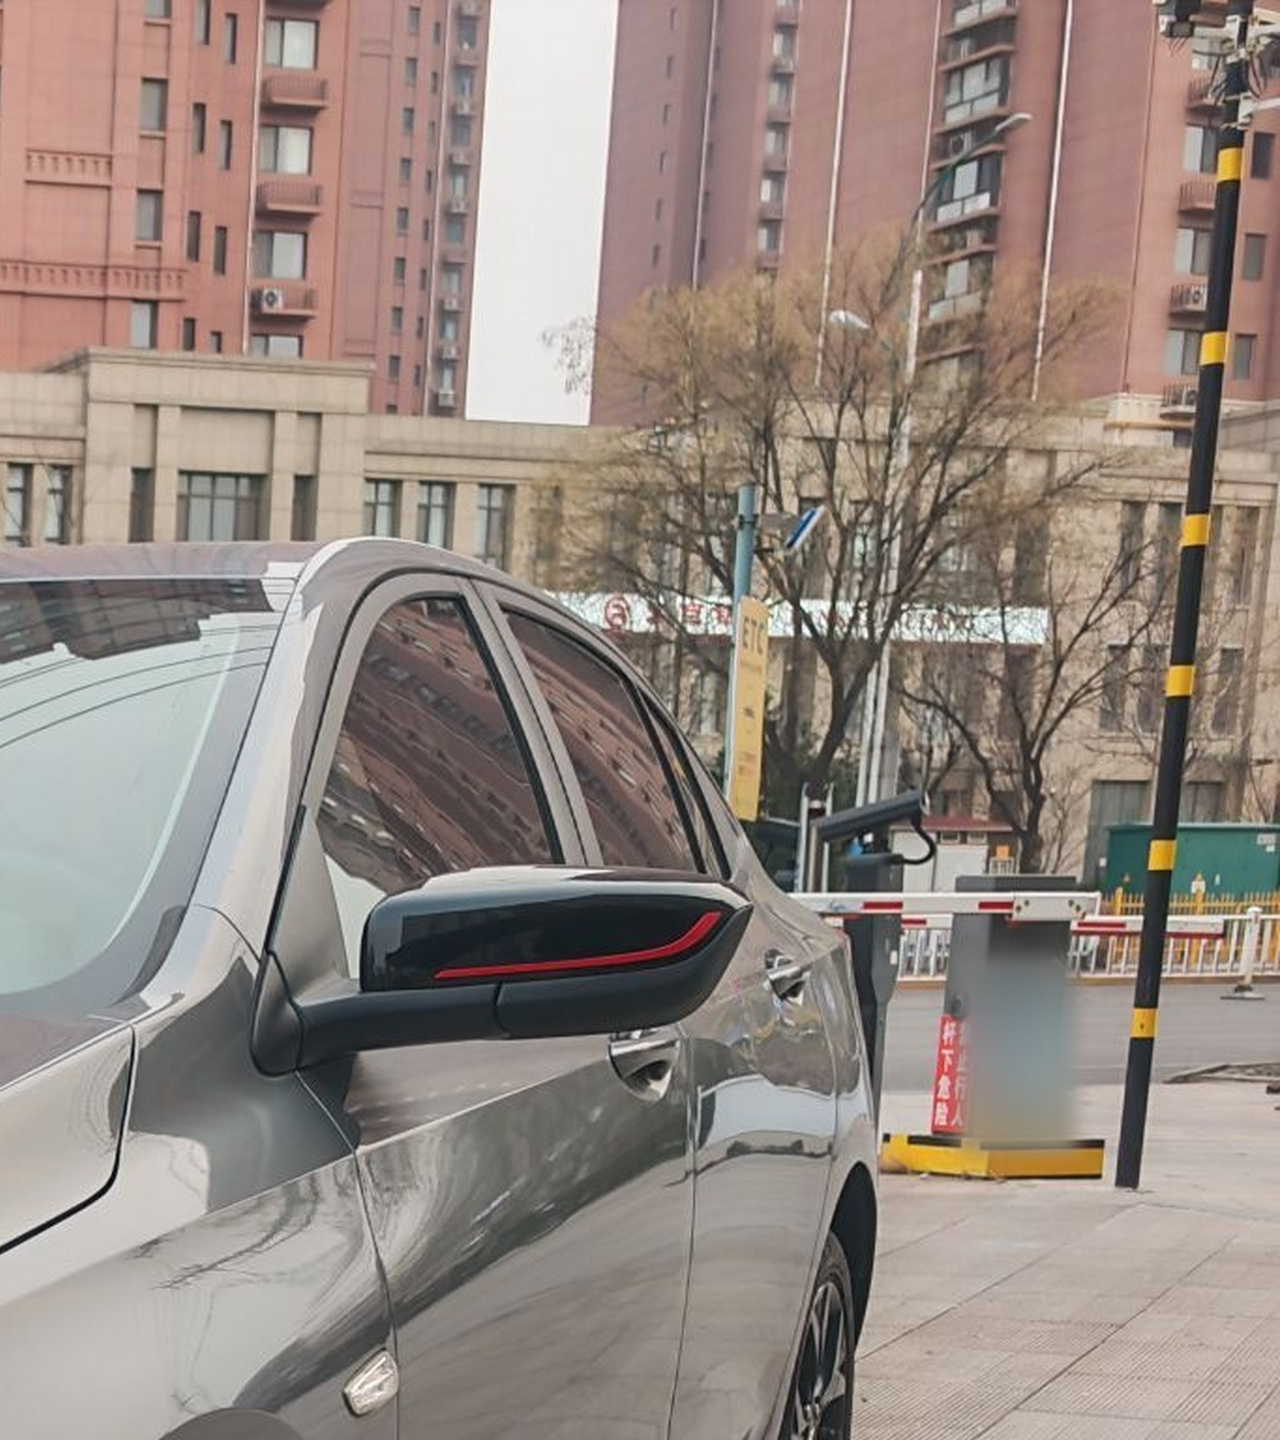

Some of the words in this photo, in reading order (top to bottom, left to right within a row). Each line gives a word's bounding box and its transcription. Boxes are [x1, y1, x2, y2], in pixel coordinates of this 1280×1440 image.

[742, 616, 765, 655] ETC
[934, 1019, 956, 1126] 杆下危险
